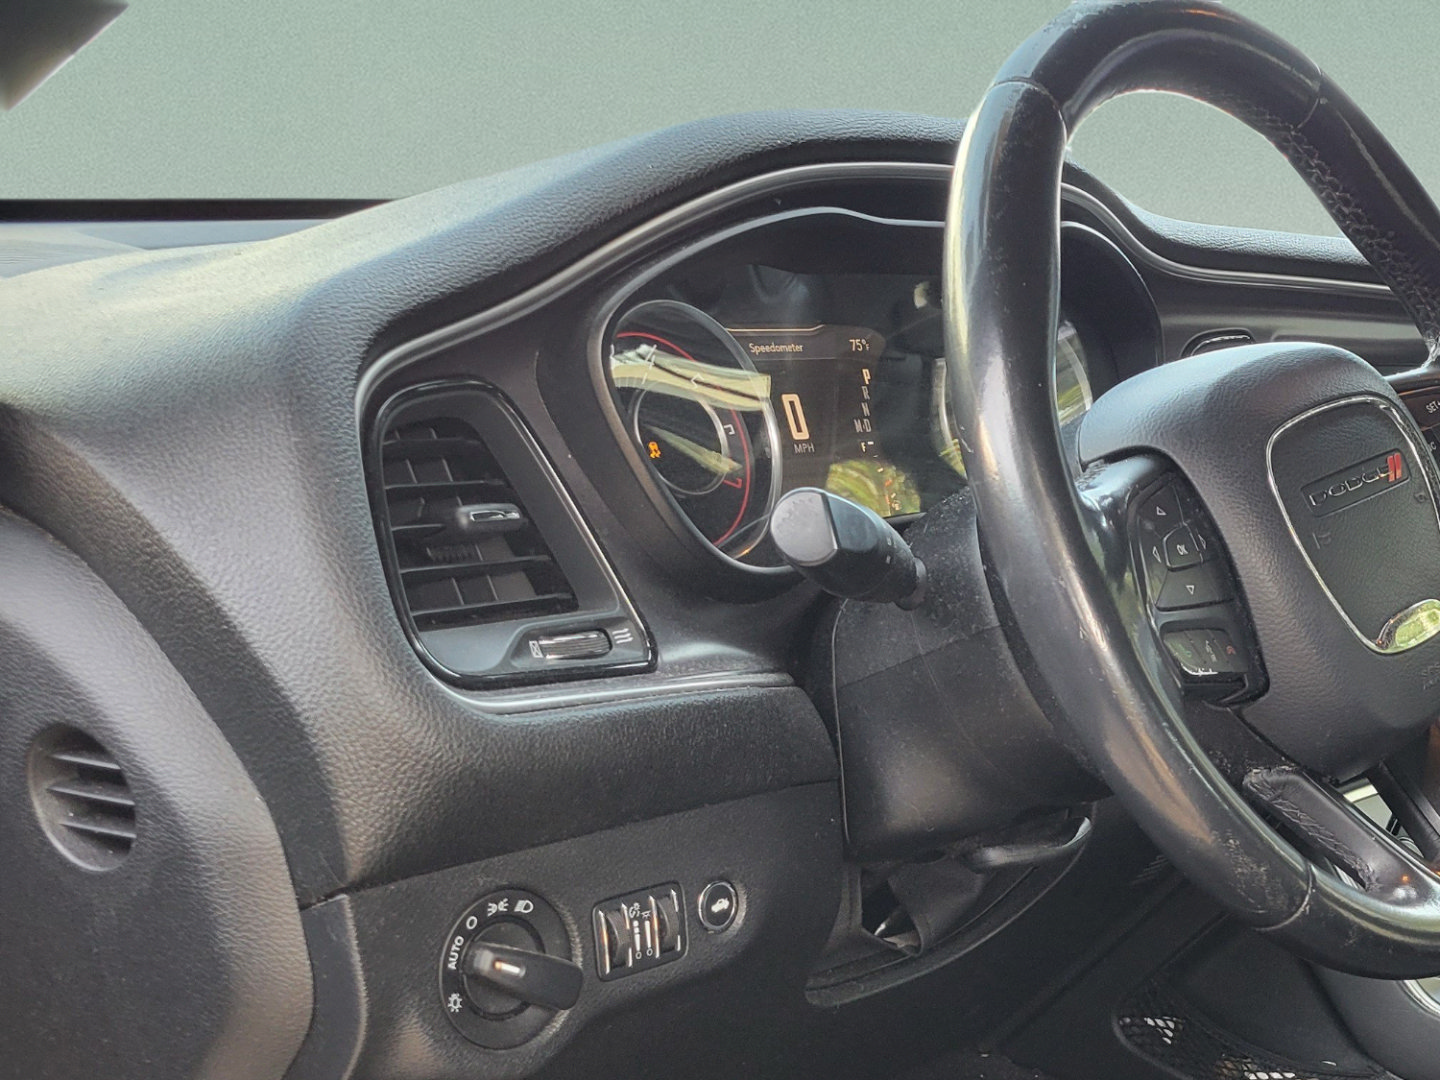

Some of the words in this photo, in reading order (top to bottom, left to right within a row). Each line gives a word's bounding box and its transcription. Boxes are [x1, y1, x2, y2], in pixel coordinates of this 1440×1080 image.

[749, 342, 803, 354] Speedometer
[862, 368, 871, 385] P
[861, 386, 870, 400] R
[781, 393, 810, 440] 0
[793, 442, 815, 454] MPH
[447, 935, 465, 970] AUTO
